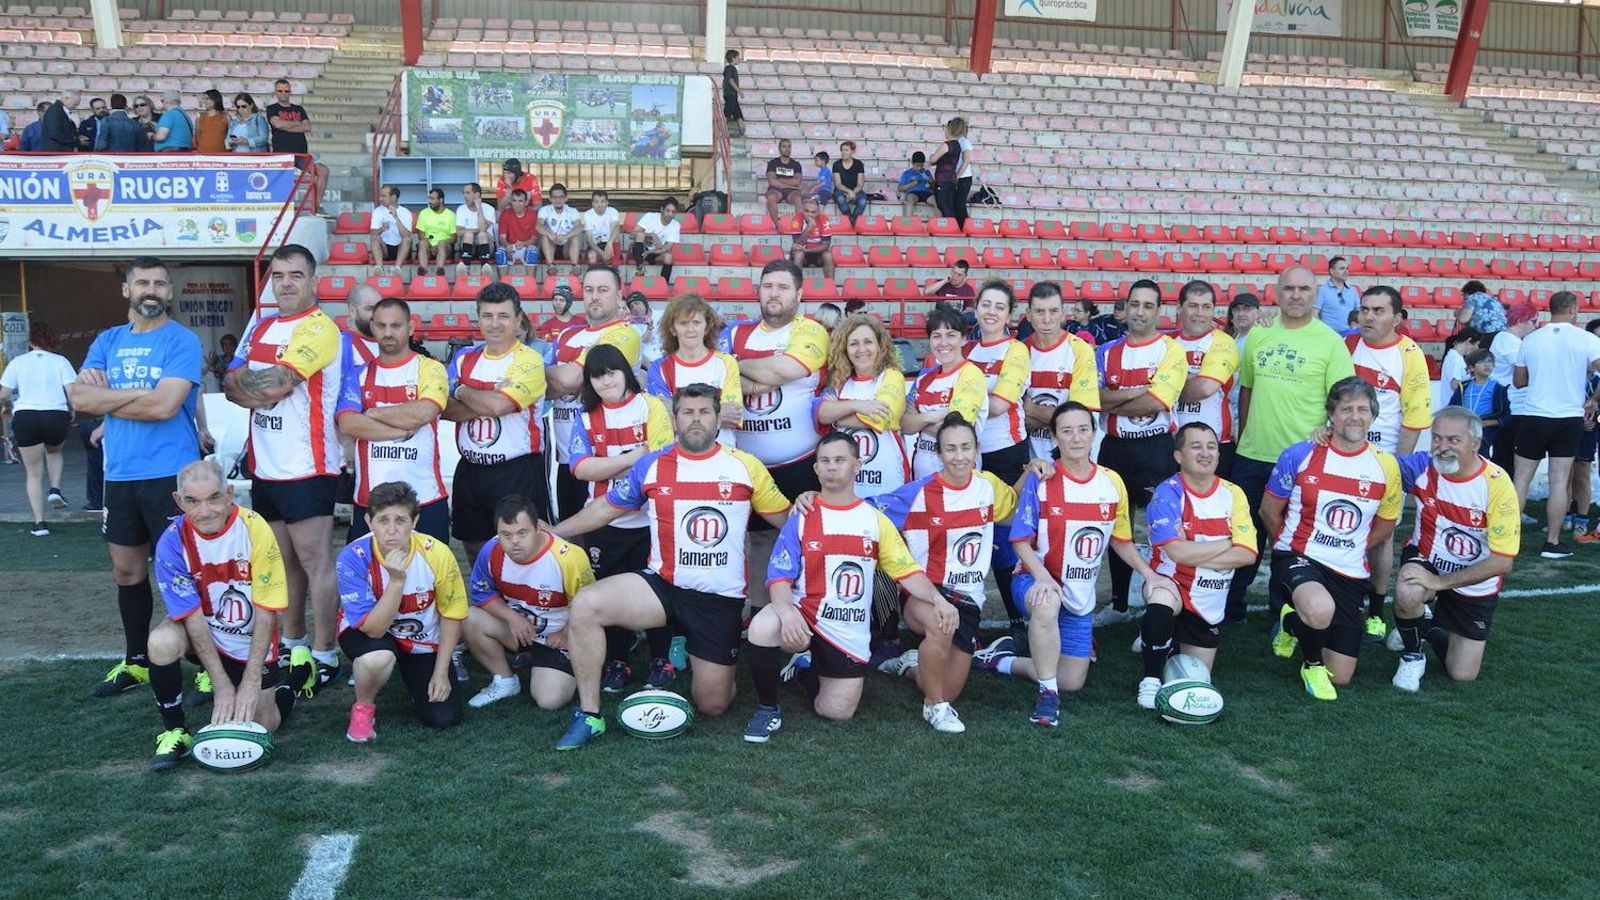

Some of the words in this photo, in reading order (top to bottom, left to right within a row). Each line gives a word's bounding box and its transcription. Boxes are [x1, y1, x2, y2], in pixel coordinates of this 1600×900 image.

[76, 172, 107, 180] URA
[119, 176, 205, 200] RUGBY
[22, 217, 165, 243] ALMERÍA
[371, 443, 418, 460] lamarca
[679, 548, 728, 567] lamarca
[821, 603, 866, 622] lamarca
